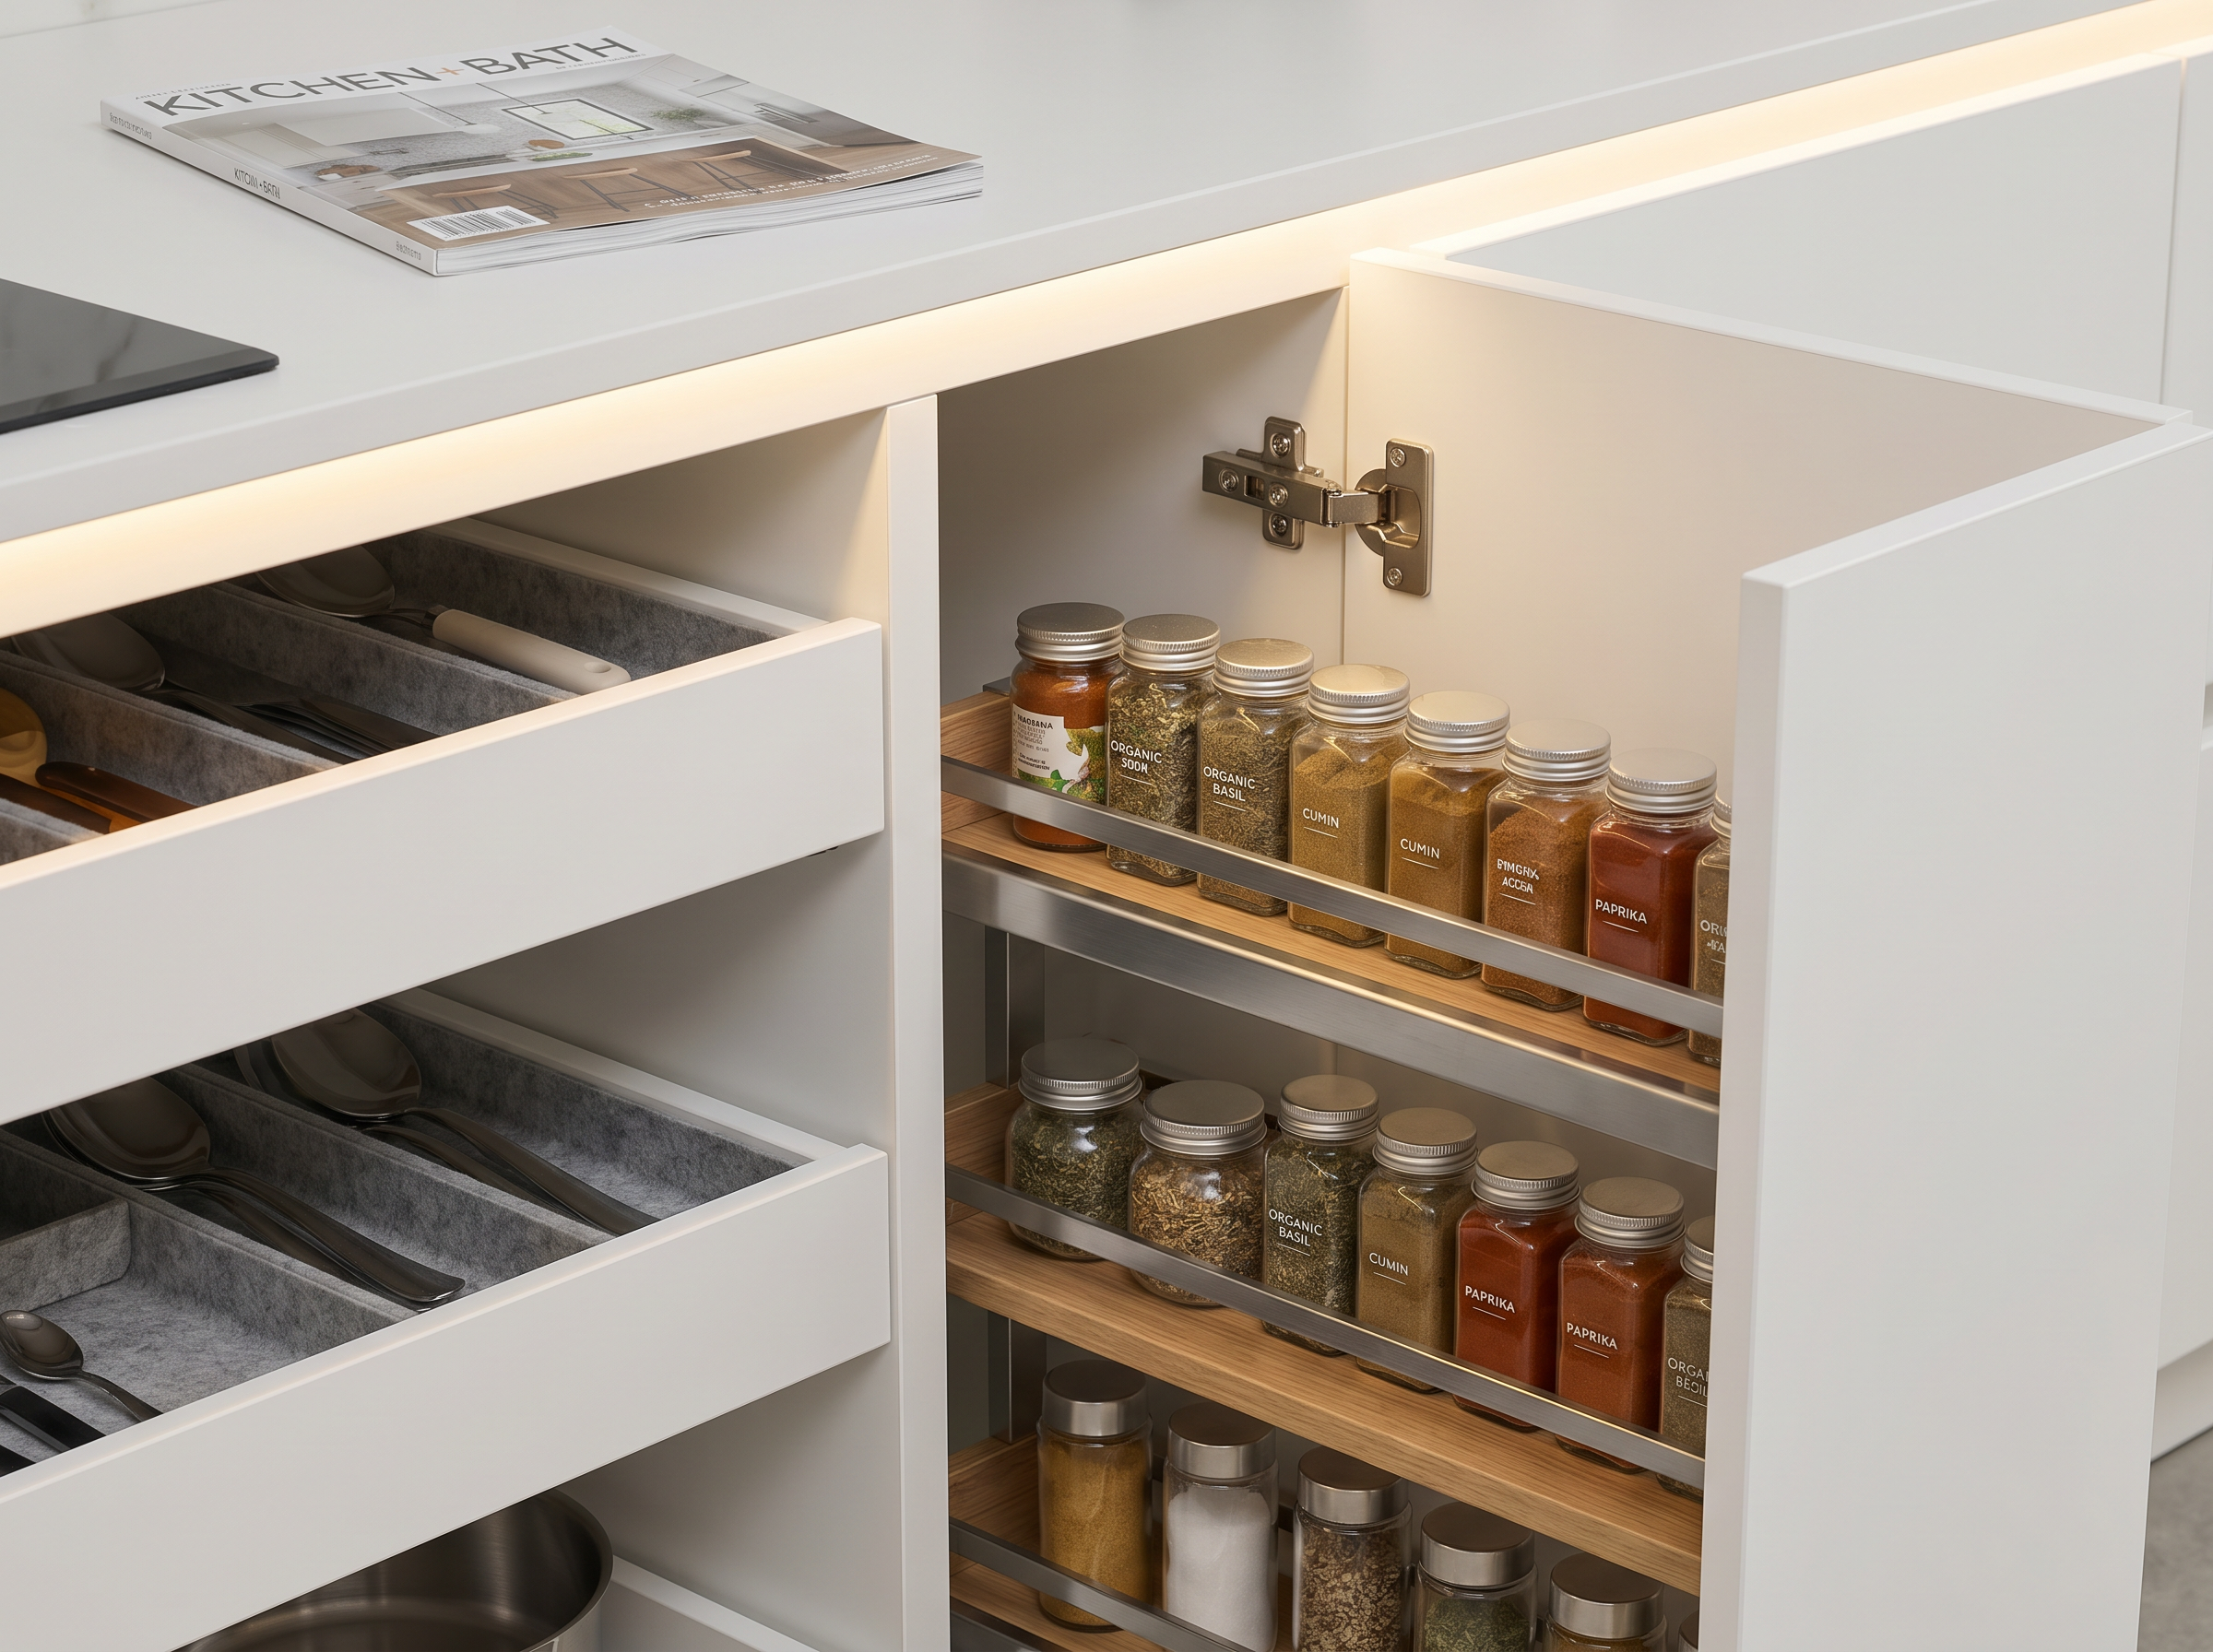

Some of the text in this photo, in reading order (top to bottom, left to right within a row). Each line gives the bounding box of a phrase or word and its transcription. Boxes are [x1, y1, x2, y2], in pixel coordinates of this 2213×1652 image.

[1110, 739, 1163, 764] ORGANIC
[1203, 766, 1256, 790] ORGANIC
[1213, 783, 1246, 803] BASIL
[1302, 808, 1340, 829] CUMIN
[1400, 838, 1440, 860] CUMIN
[1595, 898, 1648, 925] PAPRIKA
[1268, 1209, 1323, 1236] ORGANIC
[1278, 1226, 1311, 1247] BASIL
[1368, 1252, 1409, 1277] CUMIN
[1464, 1285, 1516, 1314] PAPRIKA
[1566, 1322, 1618, 1351] PAPRIKA
